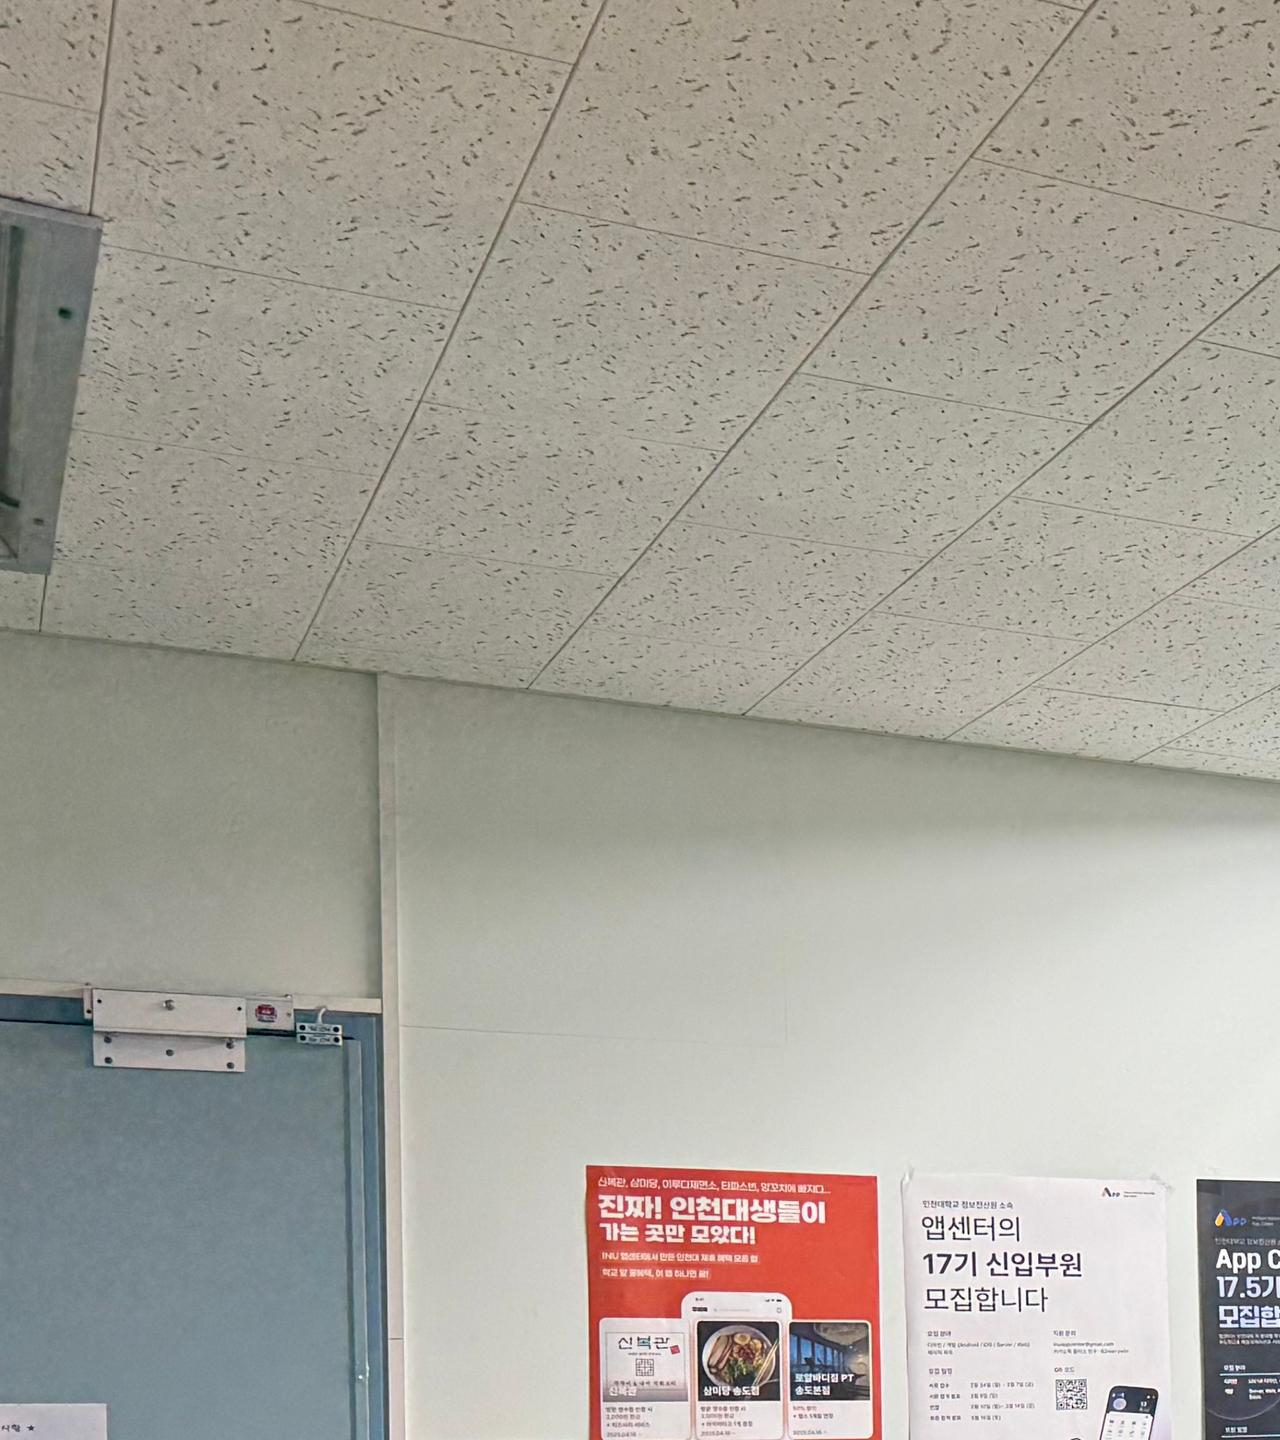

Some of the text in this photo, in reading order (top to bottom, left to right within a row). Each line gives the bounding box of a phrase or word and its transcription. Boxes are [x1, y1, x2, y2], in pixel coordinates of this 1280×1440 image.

[598, 1195, 826, 1224] 진짜! 인천대생들이
[922, 1200, 959, 1208] 인천대학교
[600, 1223, 756, 1245] 가는 곳만 모았다!
[921, 1215, 1020, 1241] 앱센터의
[923, 1251, 1082, 1277] 17기 신입부원
[1216, 1249, 1261, 1274] App
[924, 1287, 1048, 1313] 모집합니다
[841, 1374, 854, 1382] PT
[703, 1386, 730, 1396] 삼미당
